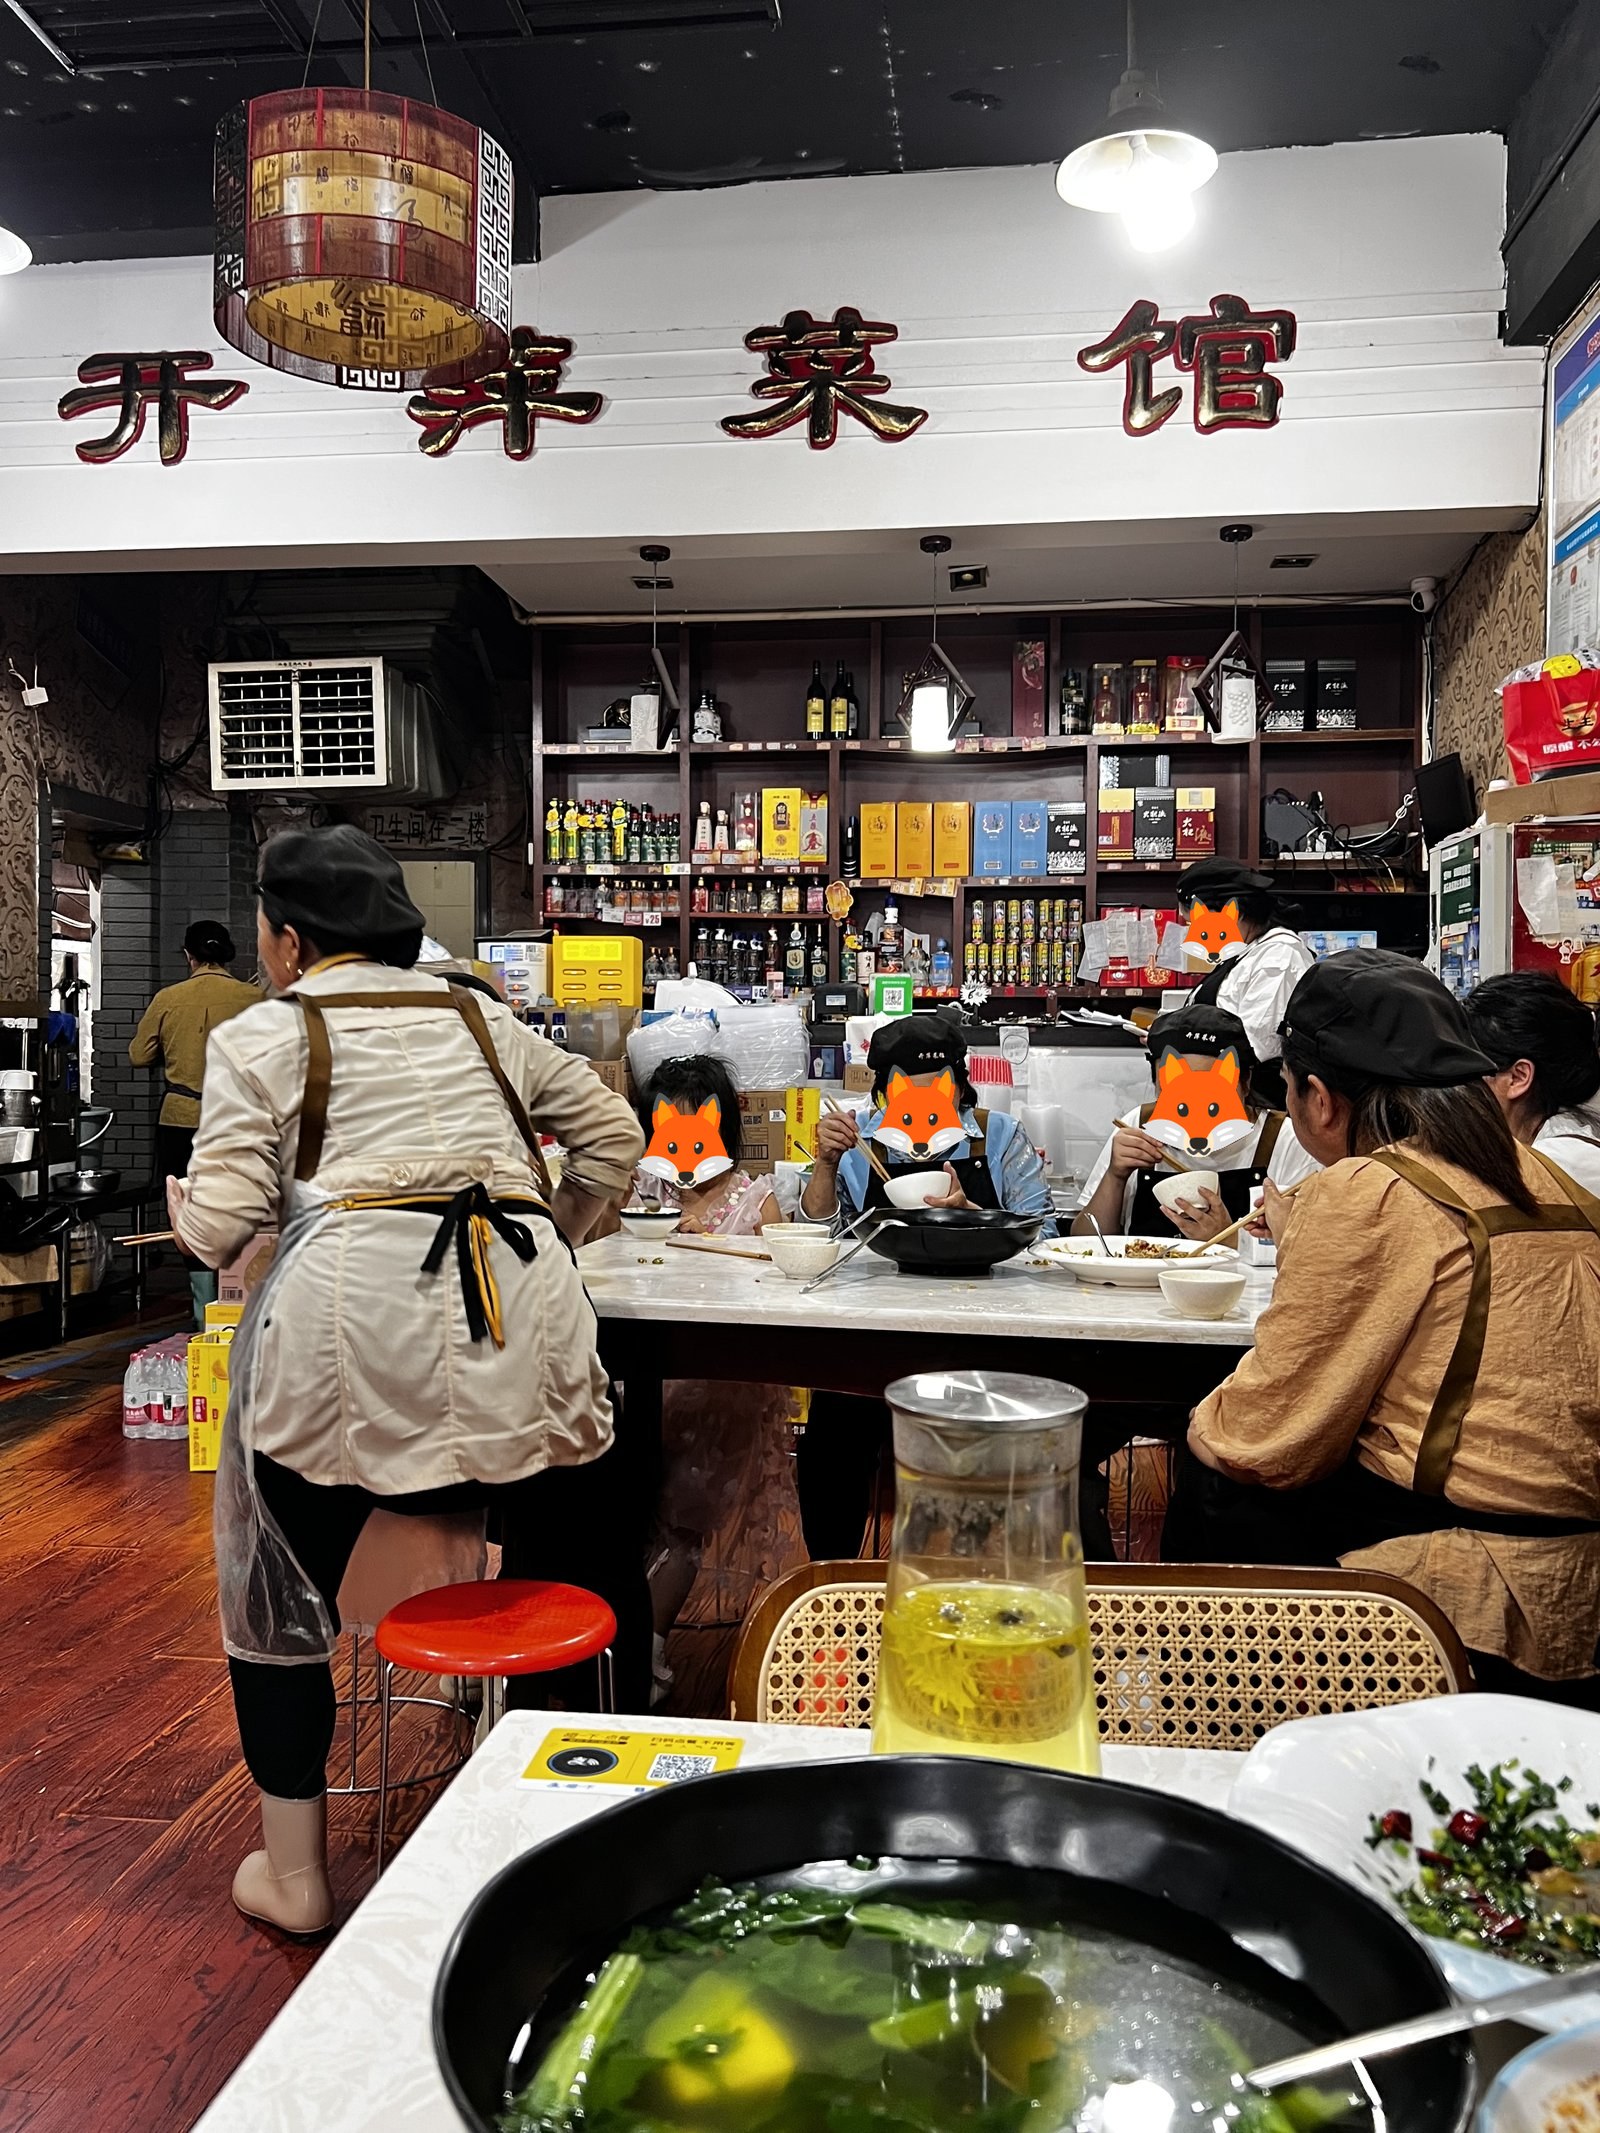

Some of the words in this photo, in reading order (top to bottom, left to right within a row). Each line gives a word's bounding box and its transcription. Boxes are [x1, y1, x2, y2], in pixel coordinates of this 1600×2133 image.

[370, 811, 486, 845] 卫生间在二楼
